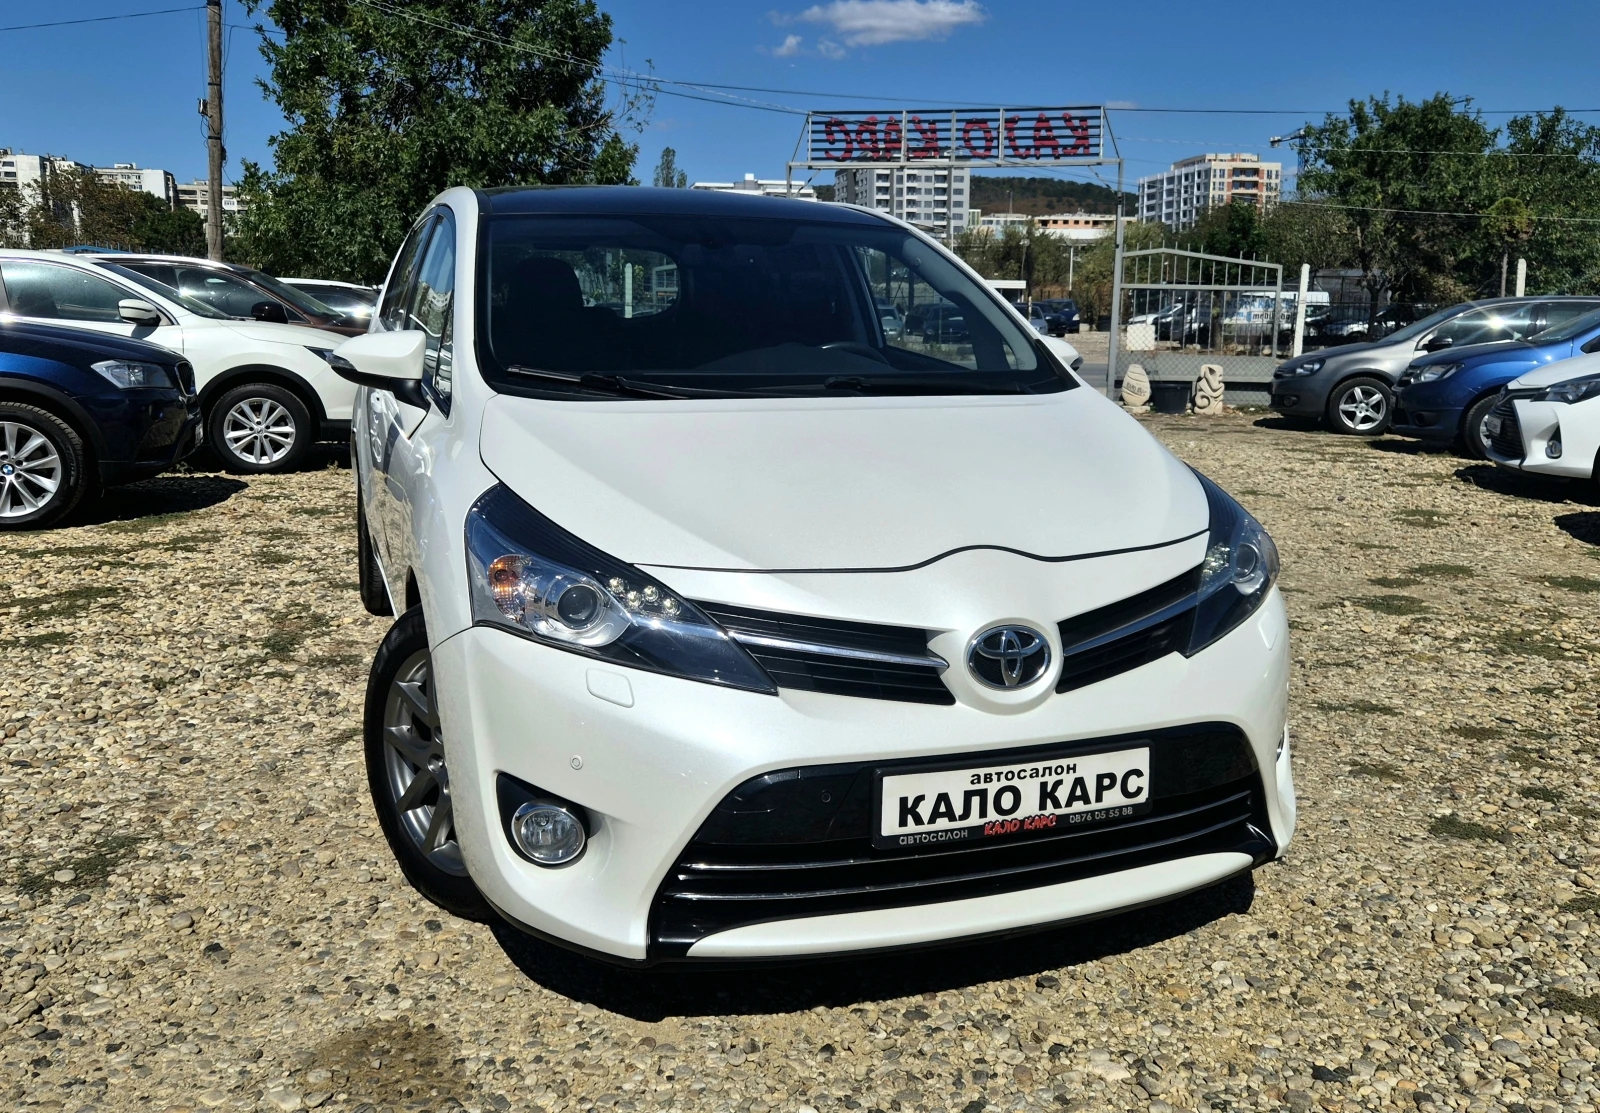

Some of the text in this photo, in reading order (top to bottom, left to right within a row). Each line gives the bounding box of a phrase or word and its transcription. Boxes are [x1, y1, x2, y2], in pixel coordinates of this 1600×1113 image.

[970, 763, 1077, 785] автосалон
[898, 768, 1145, 828] КАЛО КАРС
[899, 806, 1133, 845] автосалон КАЛО КАРС 0876 05 55 88
